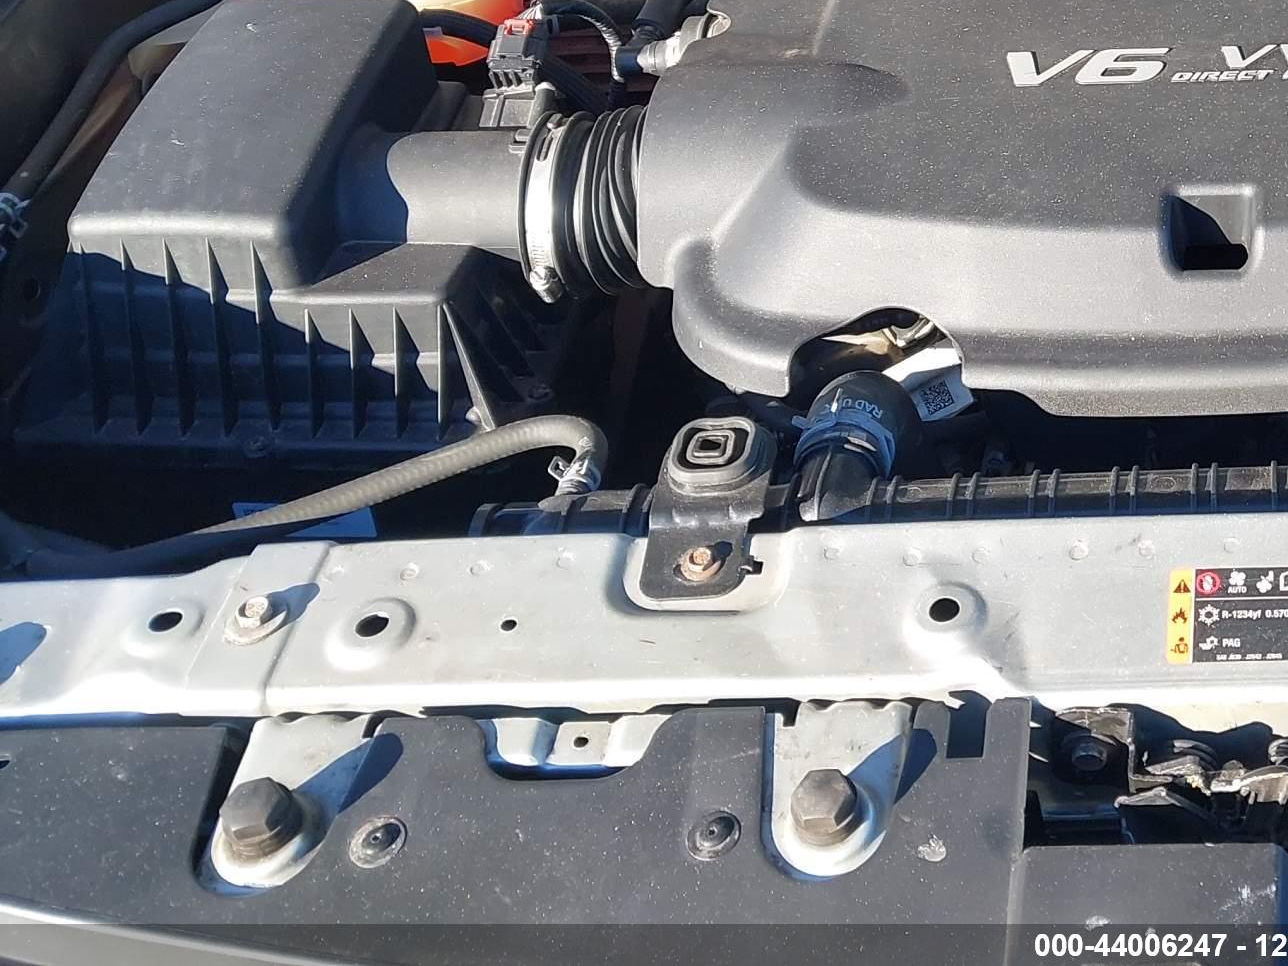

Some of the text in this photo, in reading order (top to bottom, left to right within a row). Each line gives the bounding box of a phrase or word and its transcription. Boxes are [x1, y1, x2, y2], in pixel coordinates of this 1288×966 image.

[1006, 46, 1172, 87] V6
[1170, 69, 1278, 83] DIRECT
[855, 398, 883, 420] RAD
[1227, 585, 1248, 594] AUTO
[1221, 609, 1262, 620] R-1234yf
[1222, 637, 1241, 648] PAG
